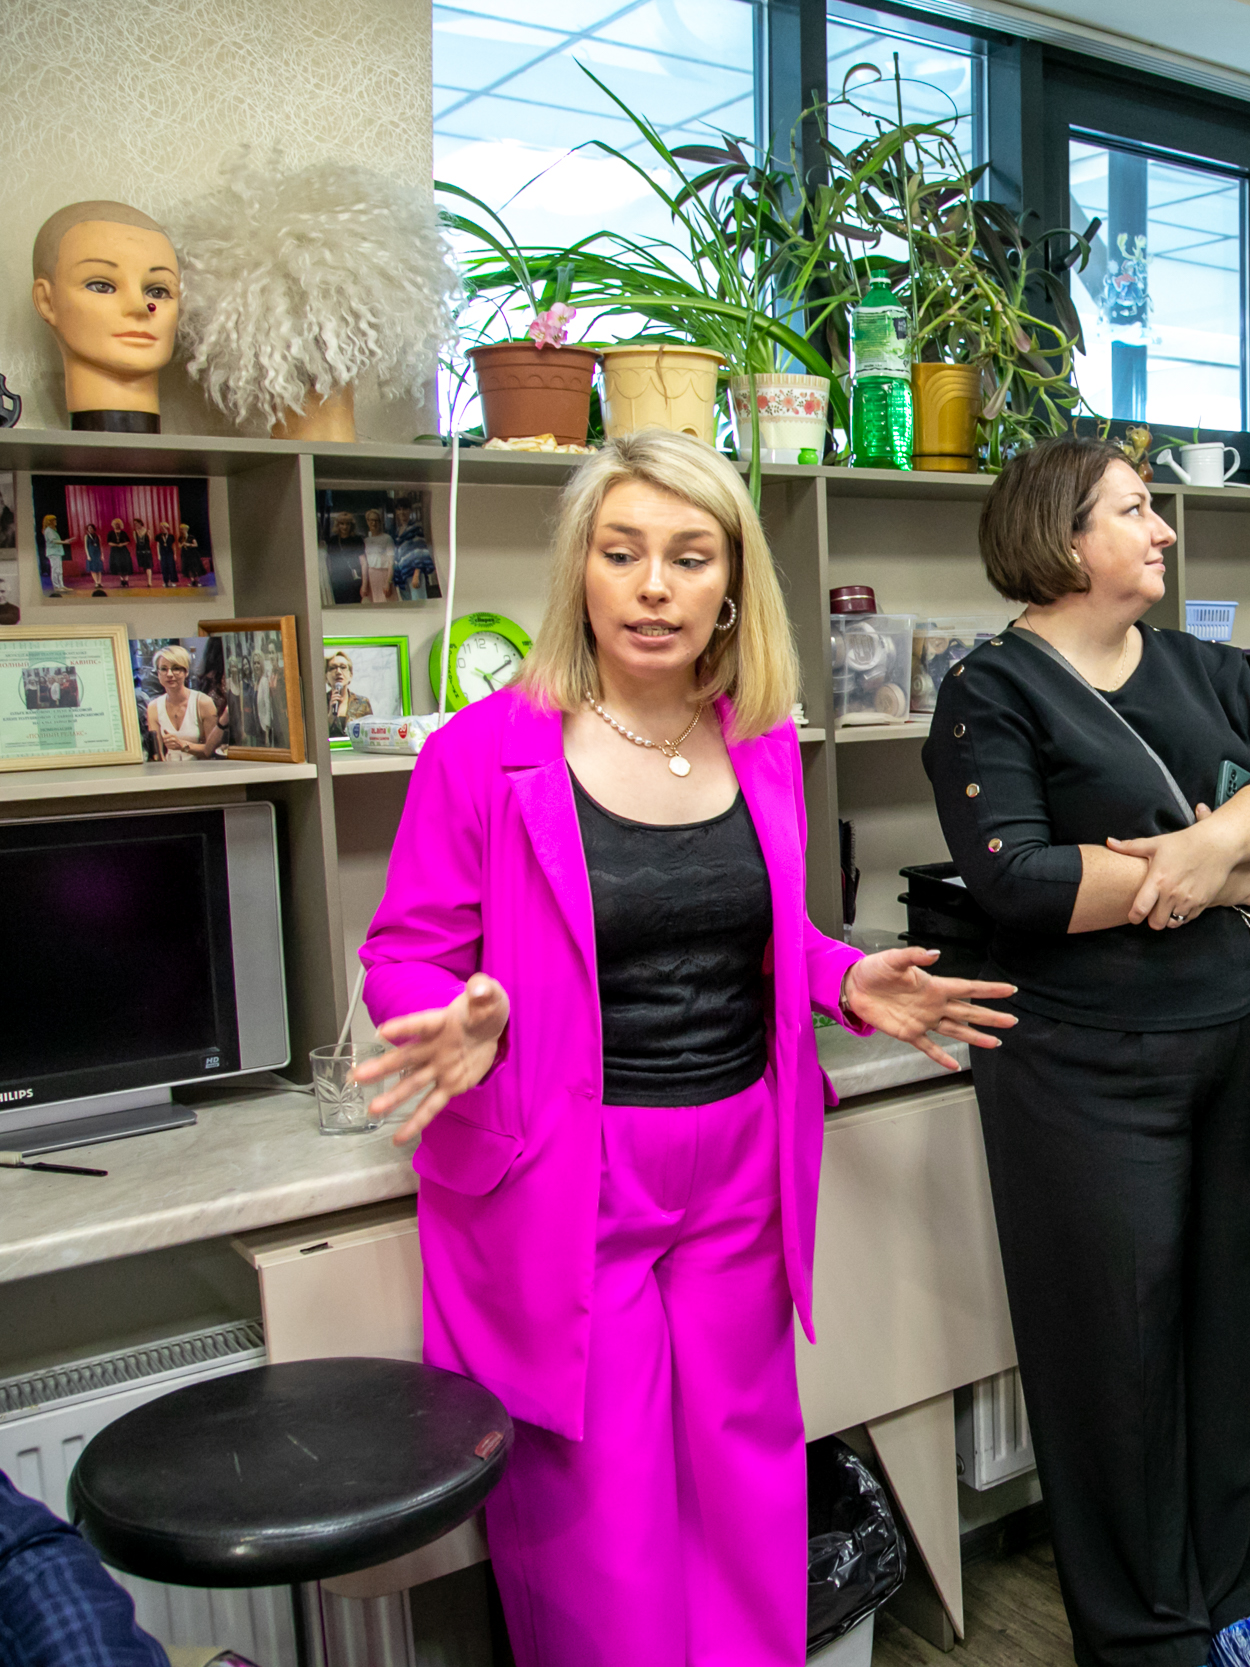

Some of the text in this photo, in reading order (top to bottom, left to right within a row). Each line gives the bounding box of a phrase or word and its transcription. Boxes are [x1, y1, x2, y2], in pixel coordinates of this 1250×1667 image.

[462, 643, 472, 654] 11
[474, 638, 486, 649] 12
[494, 642, 499, 653] 1
[456, 657, 467, 669] 0
[206, 1056, 220, 1064] HD
[0, 1088, 34, 1103] HILIPS
